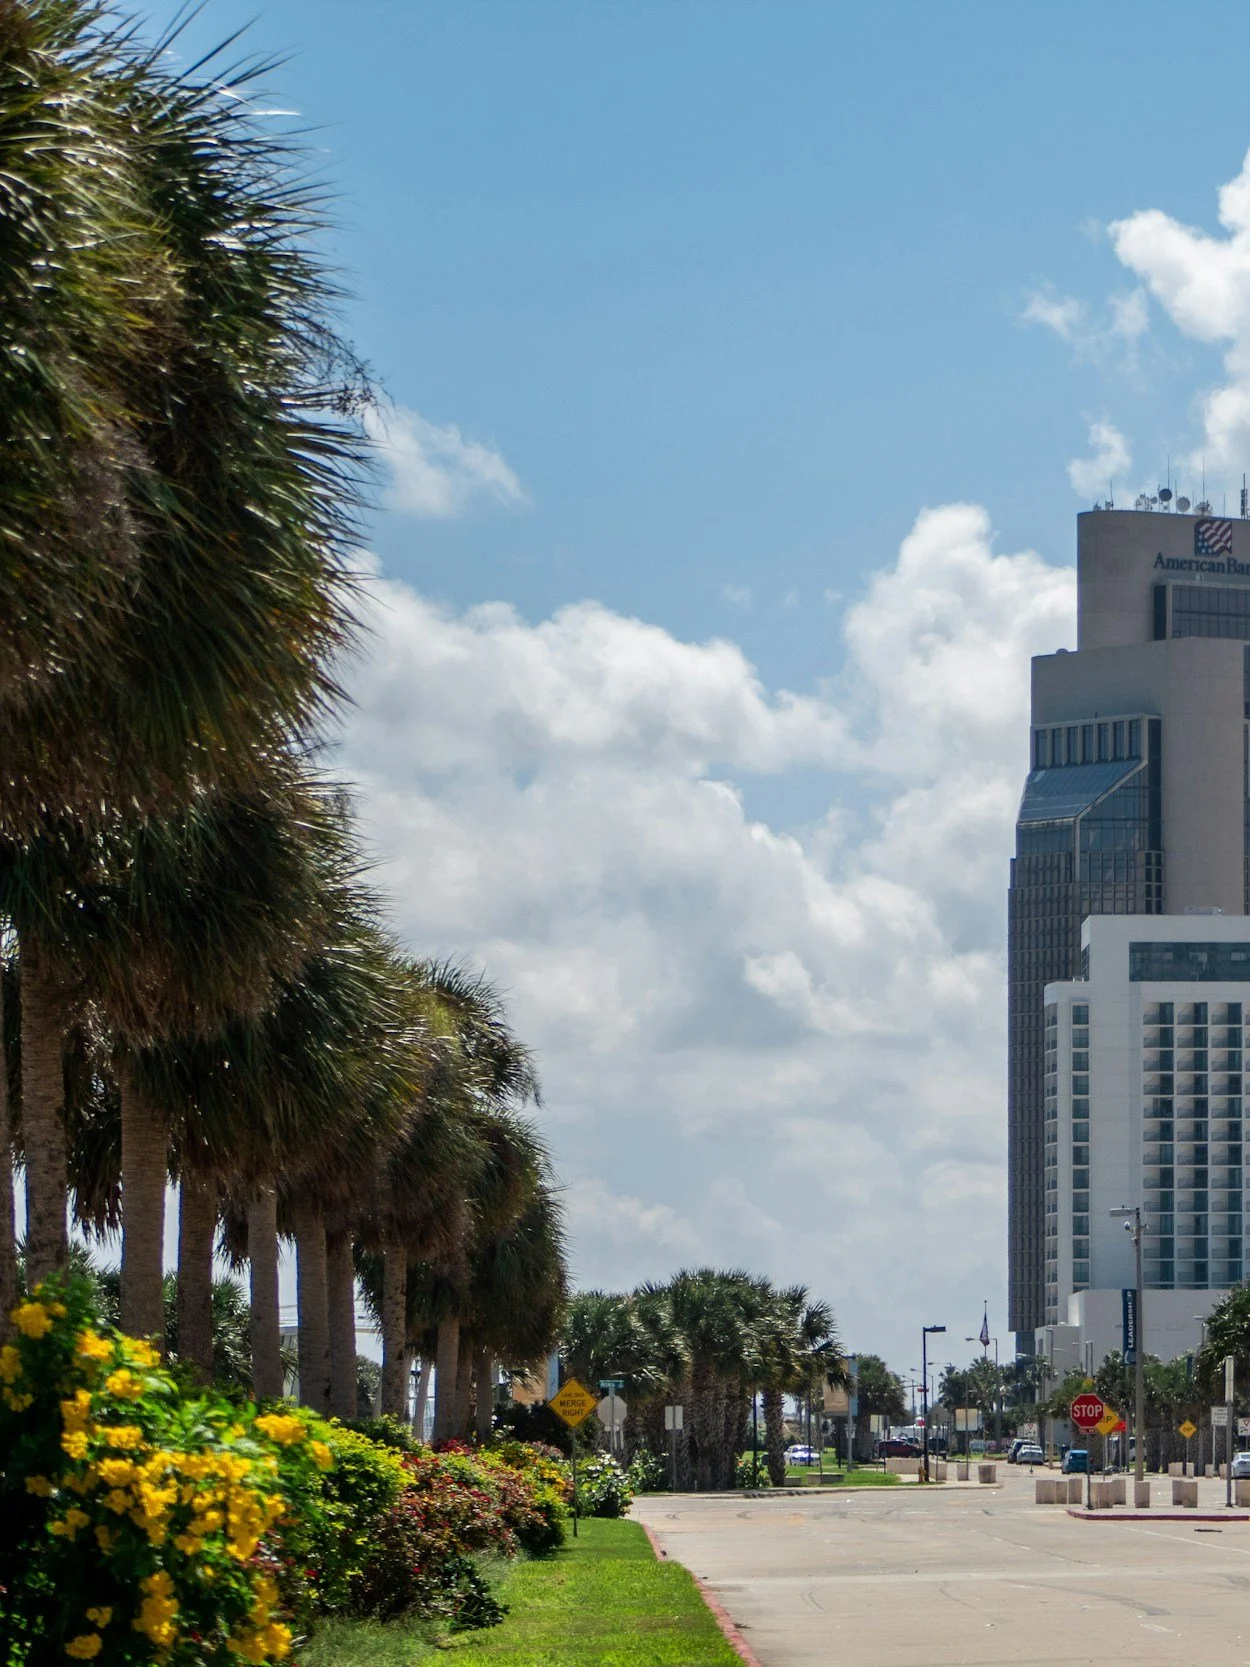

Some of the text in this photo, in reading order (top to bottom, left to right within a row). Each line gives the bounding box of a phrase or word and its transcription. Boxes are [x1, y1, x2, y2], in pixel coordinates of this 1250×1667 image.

[559, 1399, 587, 1408] MERGE
[562, 1408, 584, 1417] RIGHT
[1073, 1404, 1102, 1417] STOP
